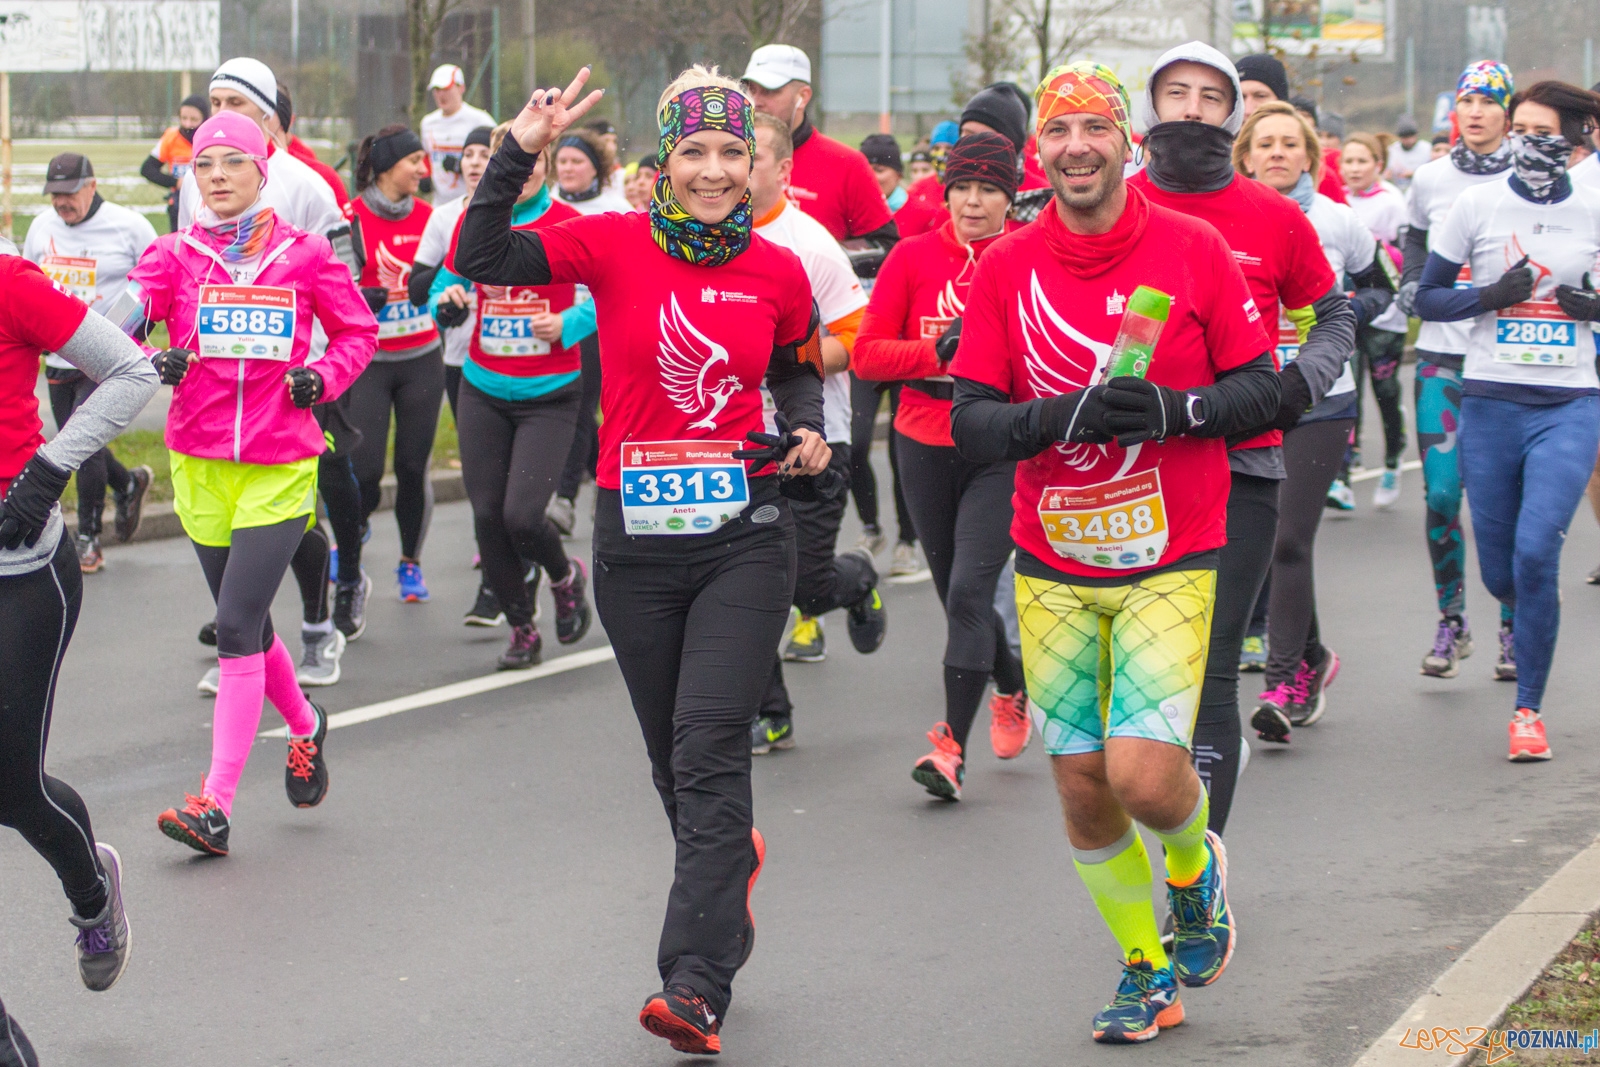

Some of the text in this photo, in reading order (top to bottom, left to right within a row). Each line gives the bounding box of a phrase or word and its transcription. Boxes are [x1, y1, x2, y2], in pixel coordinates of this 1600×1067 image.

[720, 290, 728, 302] 1
[202, 309, 285, 335] E 5885
[489, 319, 532, 338] 421
[1505, 322, 1570, 344] 2804
[645, 452, 652, 462] 1
[625, 470, 734, 503] E 3313
[1063, 496, 1071, 507] 1
[1104, 482, 1153, 500] RunPoland.org
[1059, 504, 1155, 541] 3488
[1096, 545, 1124, 553] Maciej
